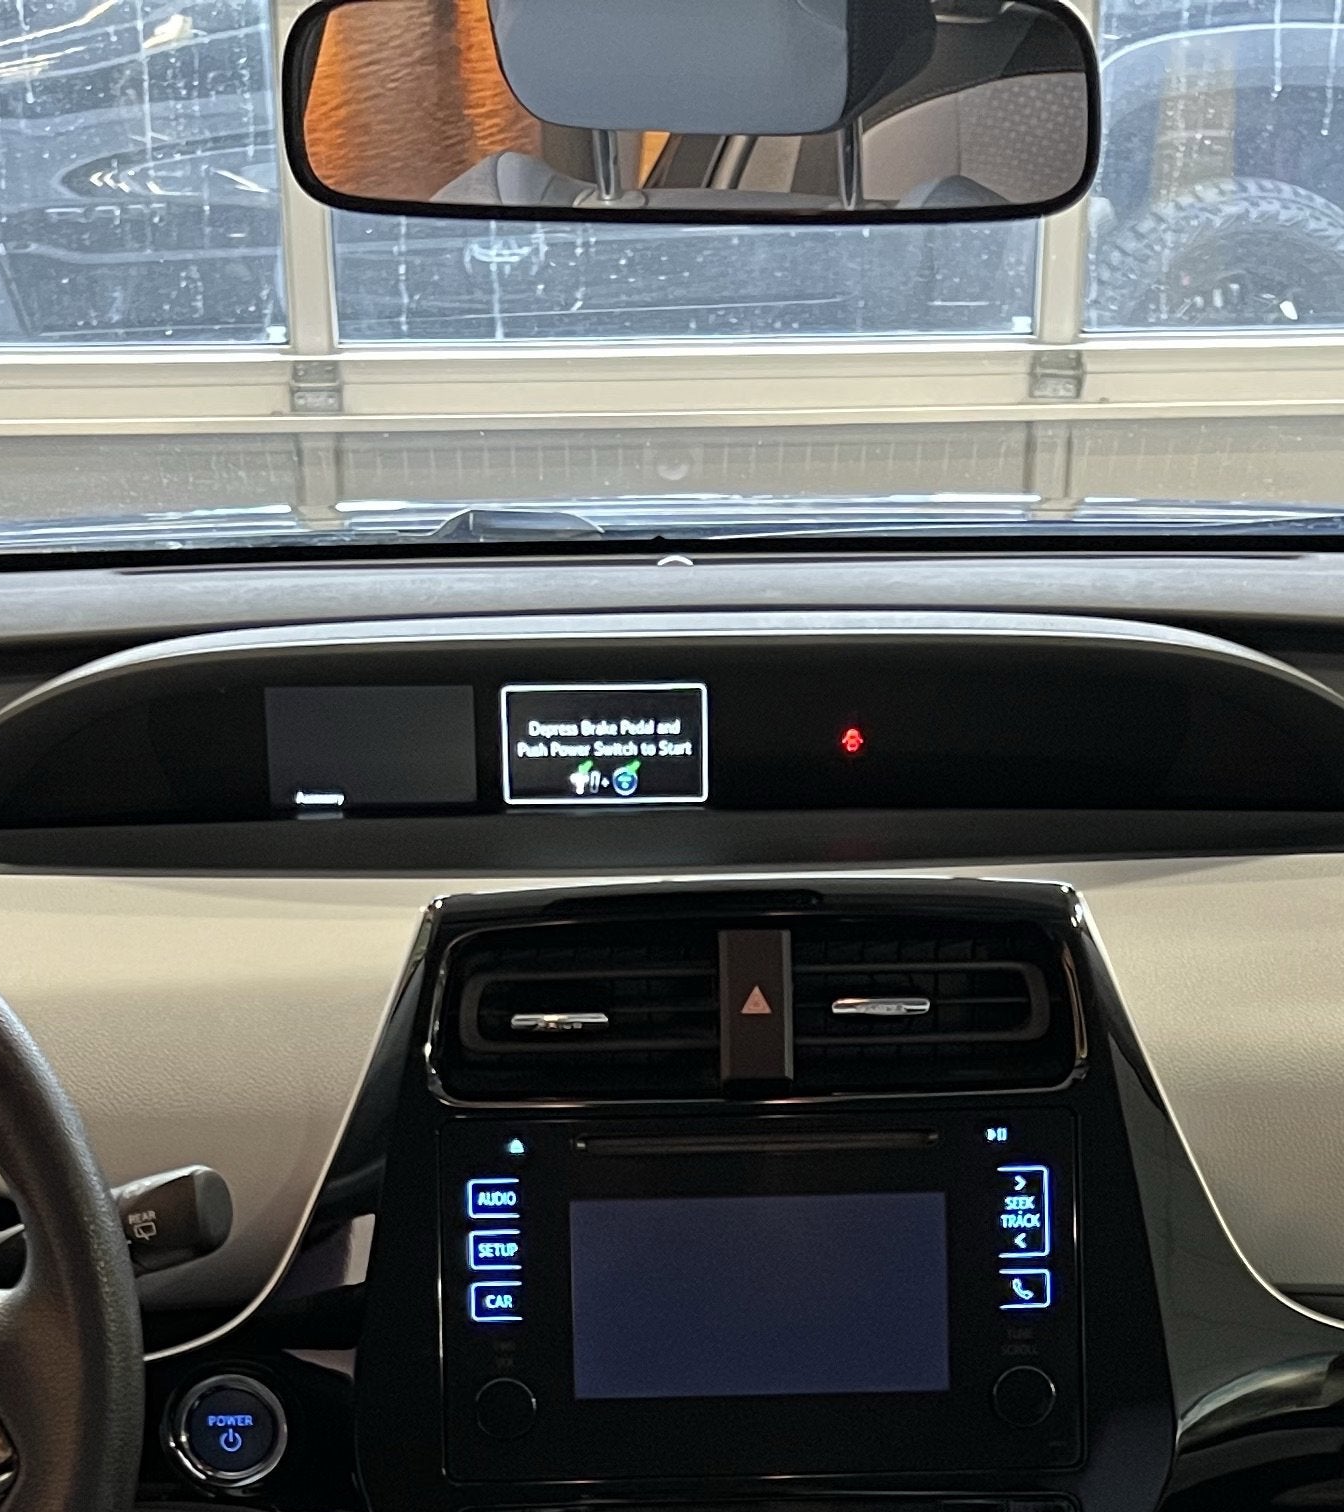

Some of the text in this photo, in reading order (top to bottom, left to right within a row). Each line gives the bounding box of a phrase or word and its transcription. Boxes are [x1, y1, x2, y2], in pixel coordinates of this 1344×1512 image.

[580, 719, 618, 736] Brake
[620, 719, 655, 735] Pedal
[657, 718, 681, 735] and
[517, 740, 693, 757] Push Power Switch to Start
[477, 1191, 517, 1206] AUDIO
[1004, 1195, 1036, 1210] SEEK
[1000, 1213, 1041, 1228] TRACK
[478, 1242, 519, 1258] SETUP
[484, 1295, 513, 1309] CAR
[207, 1415, 254, 1427] POWER
